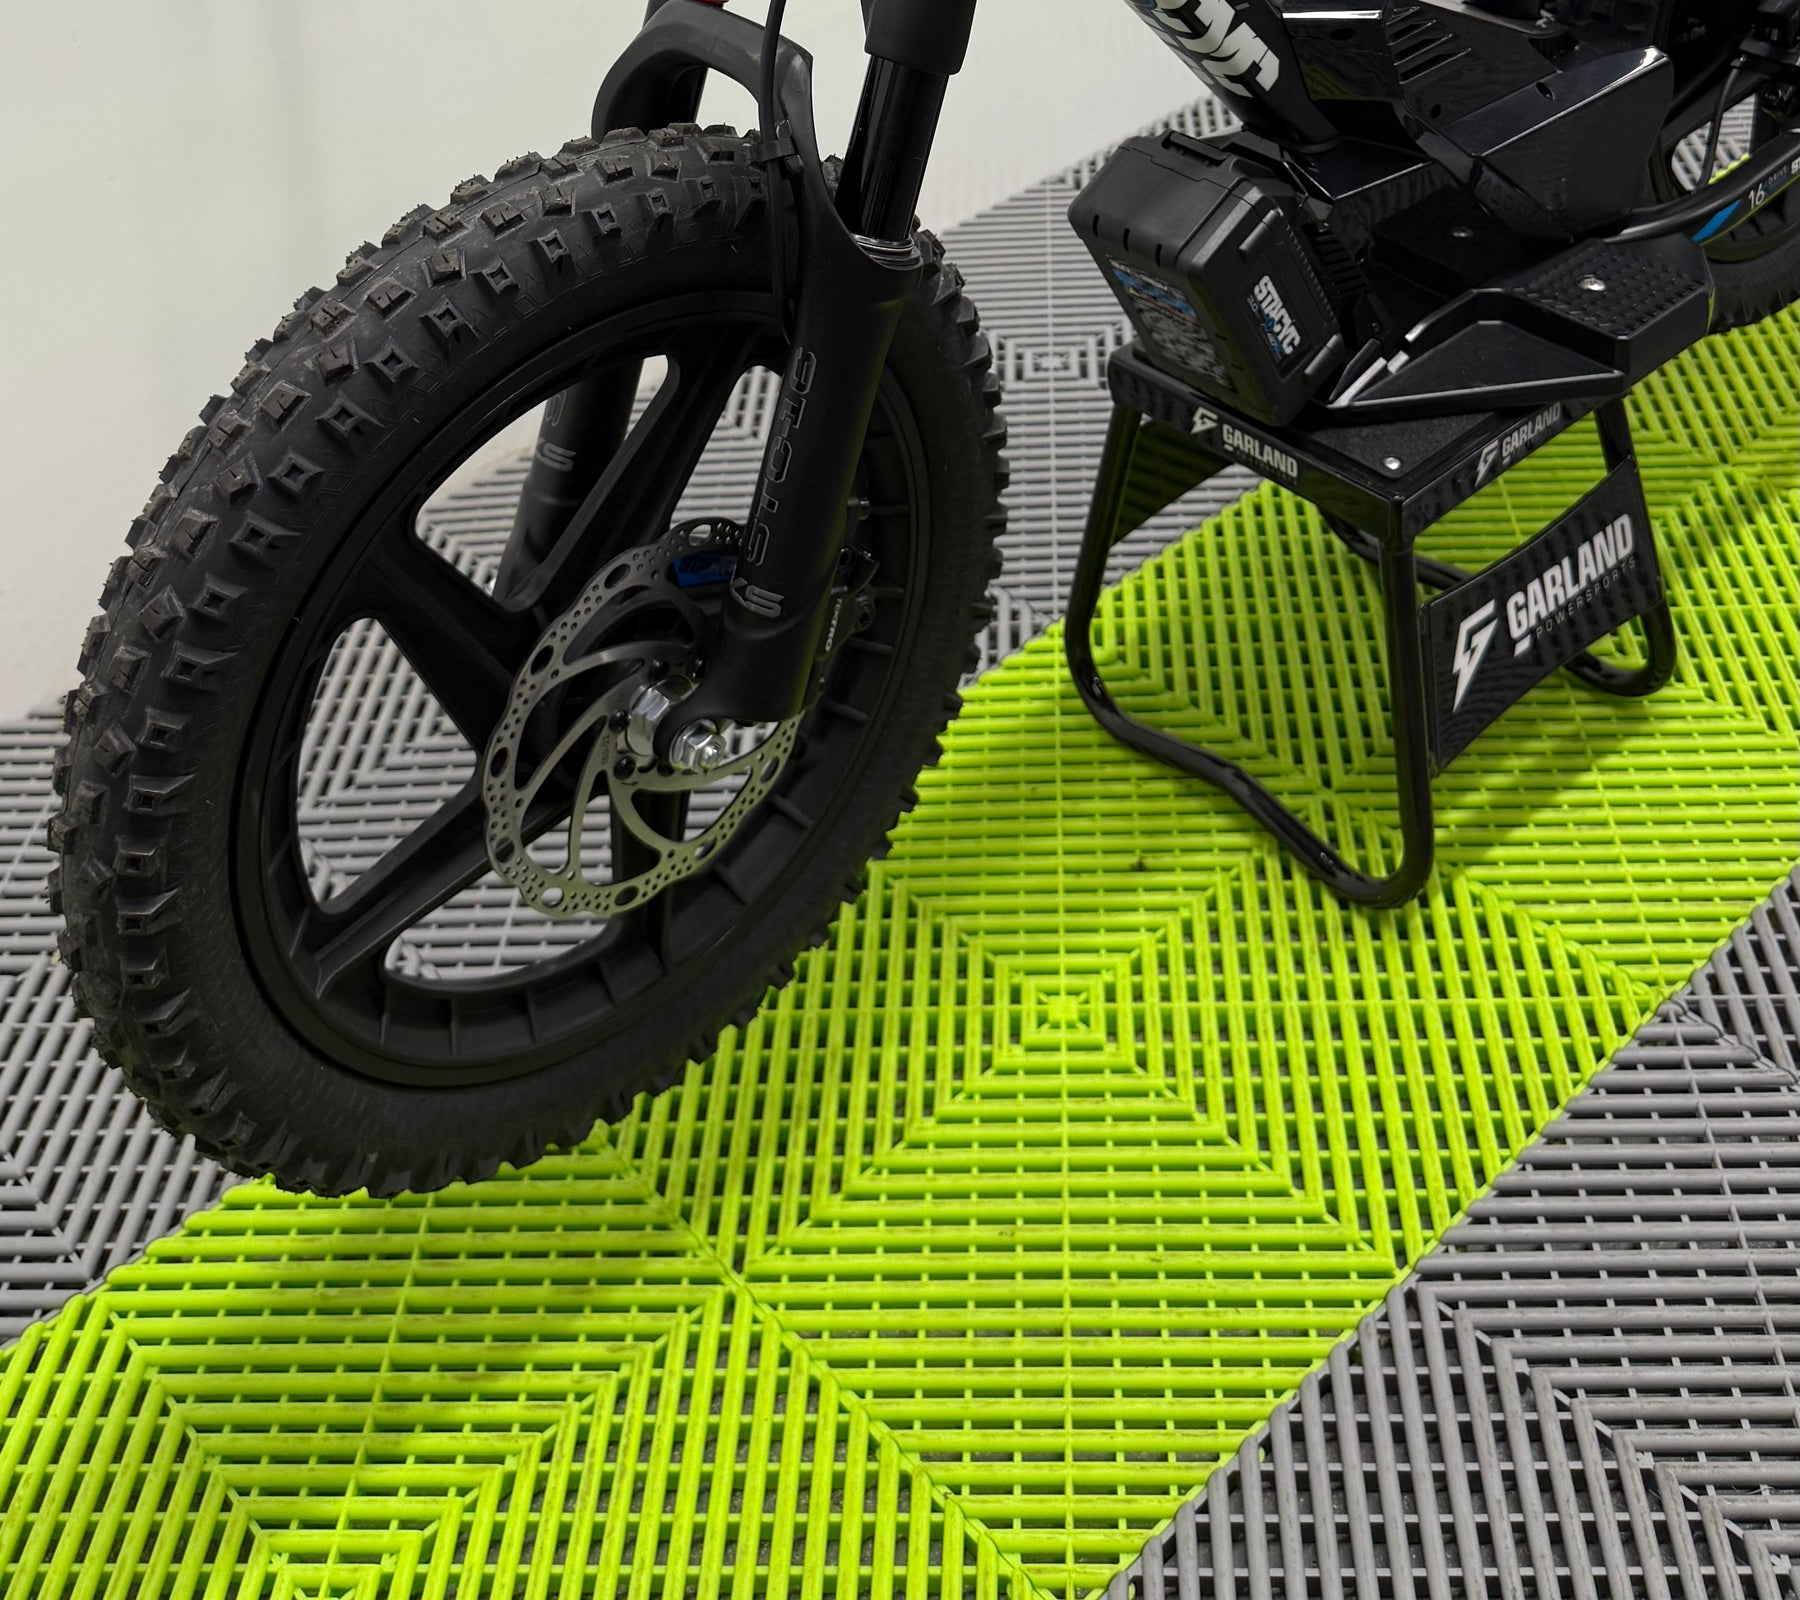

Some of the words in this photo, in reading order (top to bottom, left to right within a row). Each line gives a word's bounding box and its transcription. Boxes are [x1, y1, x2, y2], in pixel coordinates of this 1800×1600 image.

[1253, 275, 1301, 355] STACYC
[1222, 423, 1298, 478] GARLAND
[1502, 401, 1561, 459] GARLAND
[1506, 513, 1635, 641] GARLAND
[1535, 557, 1636, 641] POWERSPORTS
